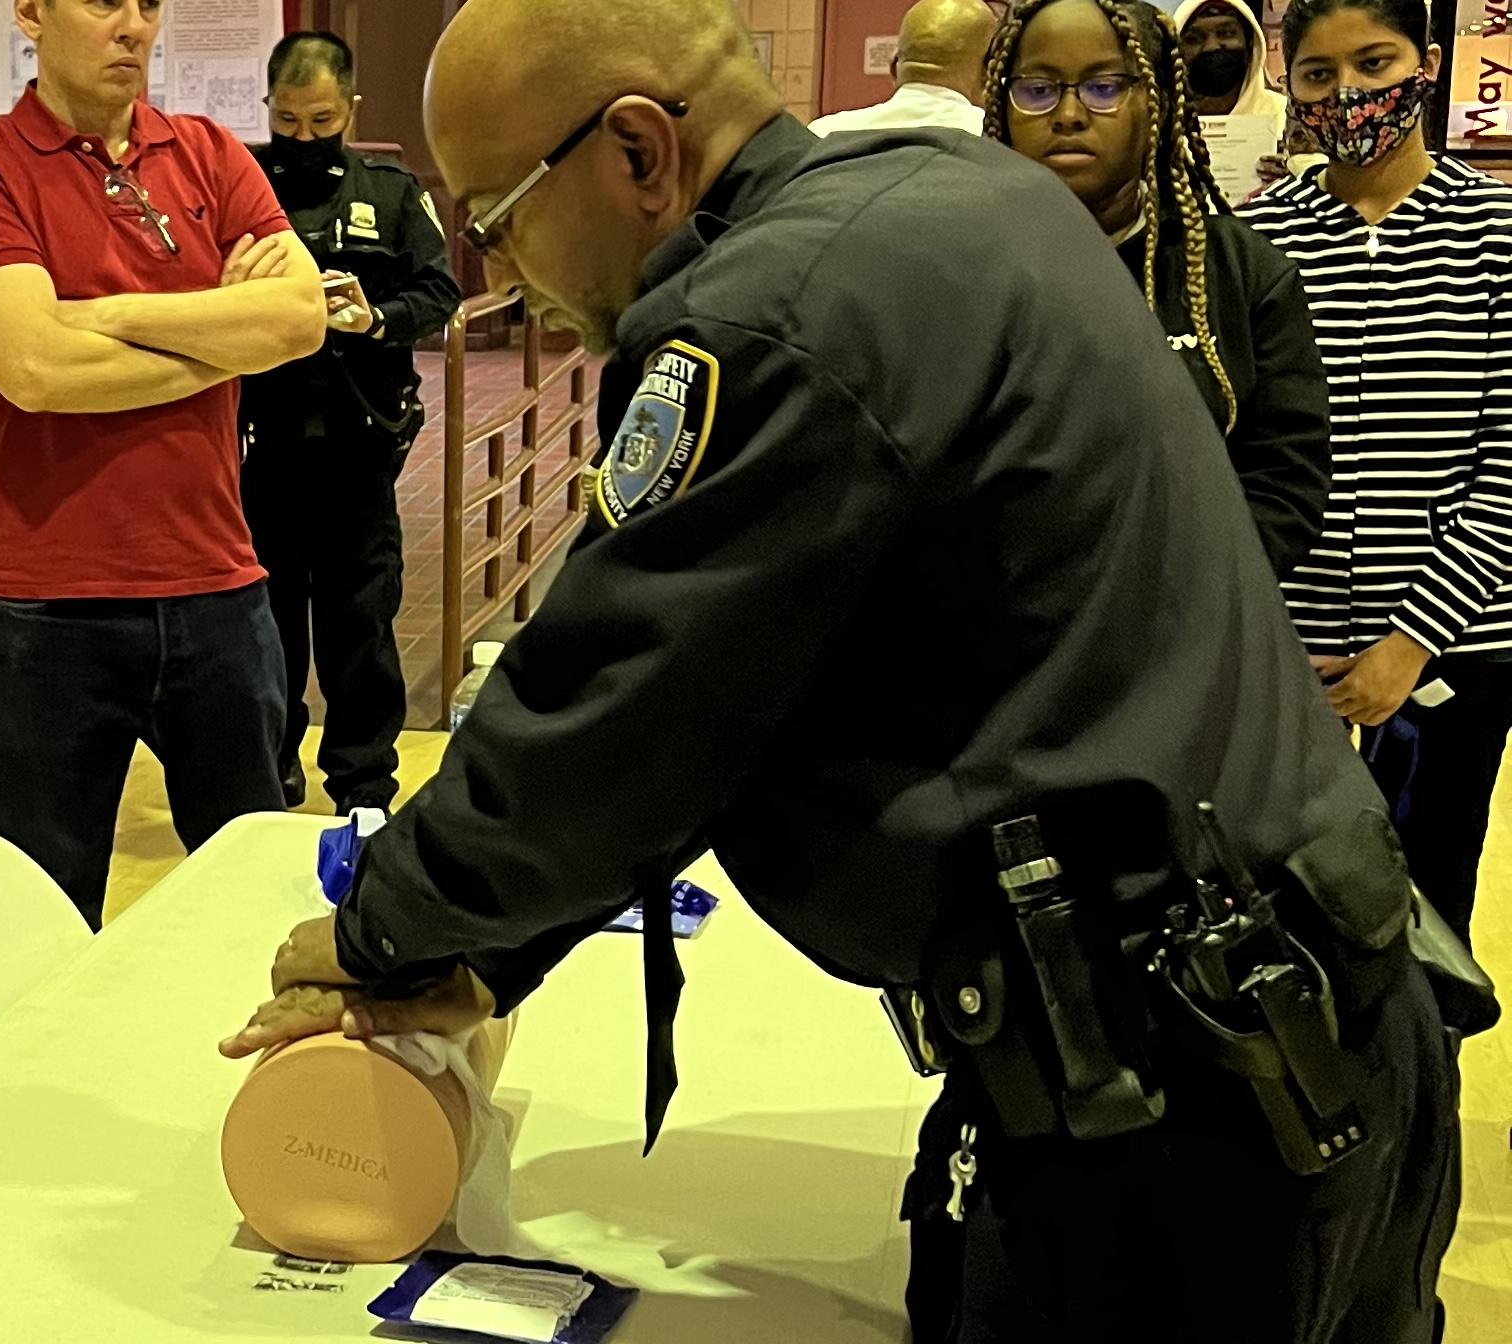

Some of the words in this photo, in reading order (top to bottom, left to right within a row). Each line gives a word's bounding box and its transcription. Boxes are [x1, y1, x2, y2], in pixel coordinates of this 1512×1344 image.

[1464, 57, 1512, 140] May
[646, 474, 673, 506] NEW
[669, 428, 698, 470] YORK
[282, 1134, 390, 1182] Z-MEDICA
